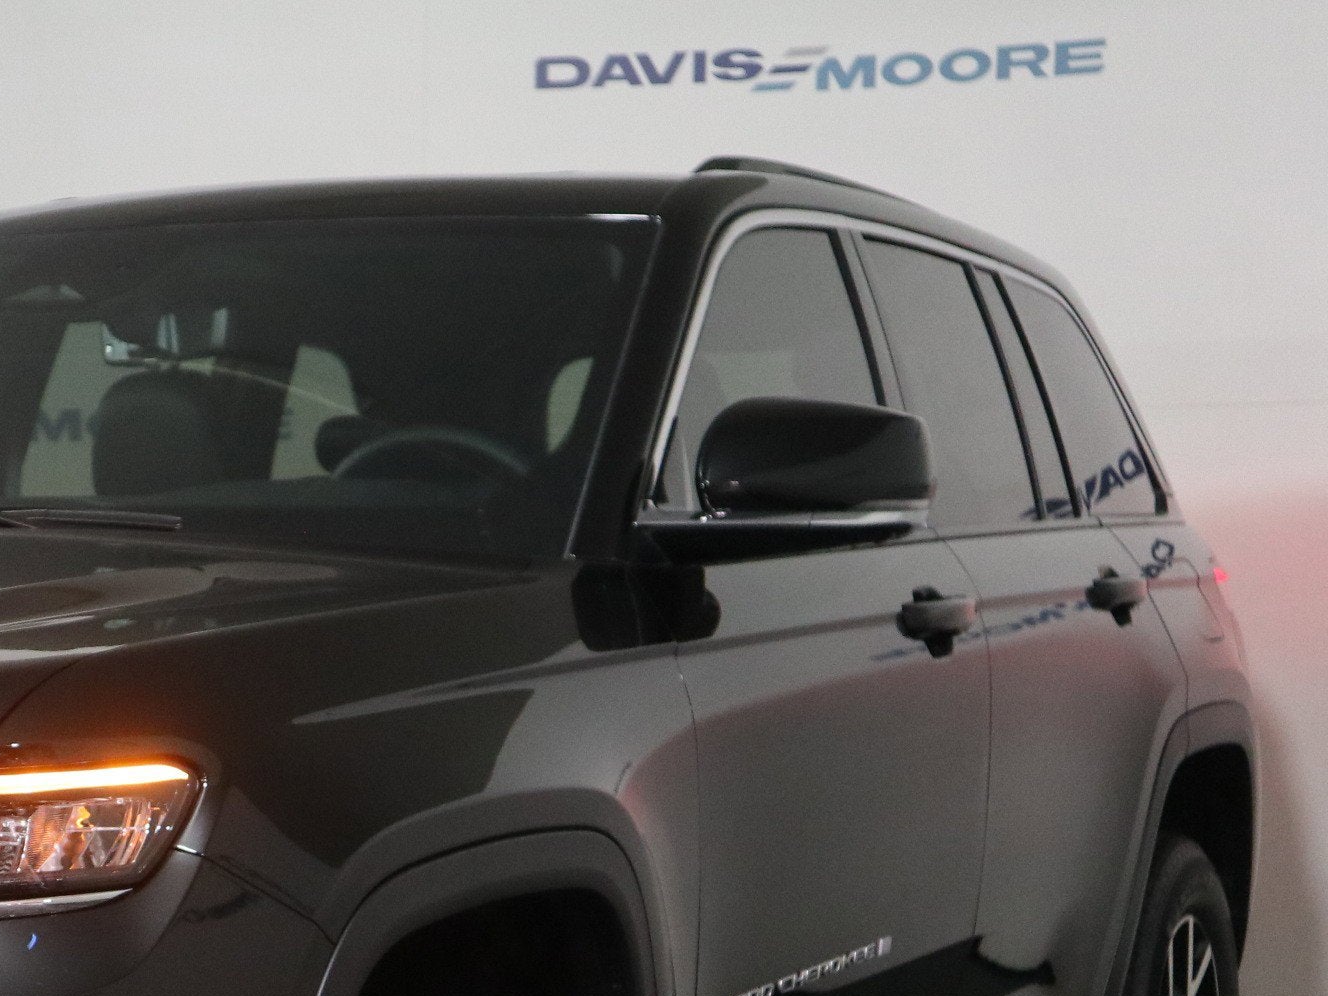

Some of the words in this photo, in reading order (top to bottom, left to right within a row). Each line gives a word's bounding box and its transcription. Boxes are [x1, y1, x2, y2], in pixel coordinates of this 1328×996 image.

[535, 48, 764, 90] DAVIS
[815, 38, 1106, 91] MOORE
[777, 942, 876, 993] CHEROKEE
